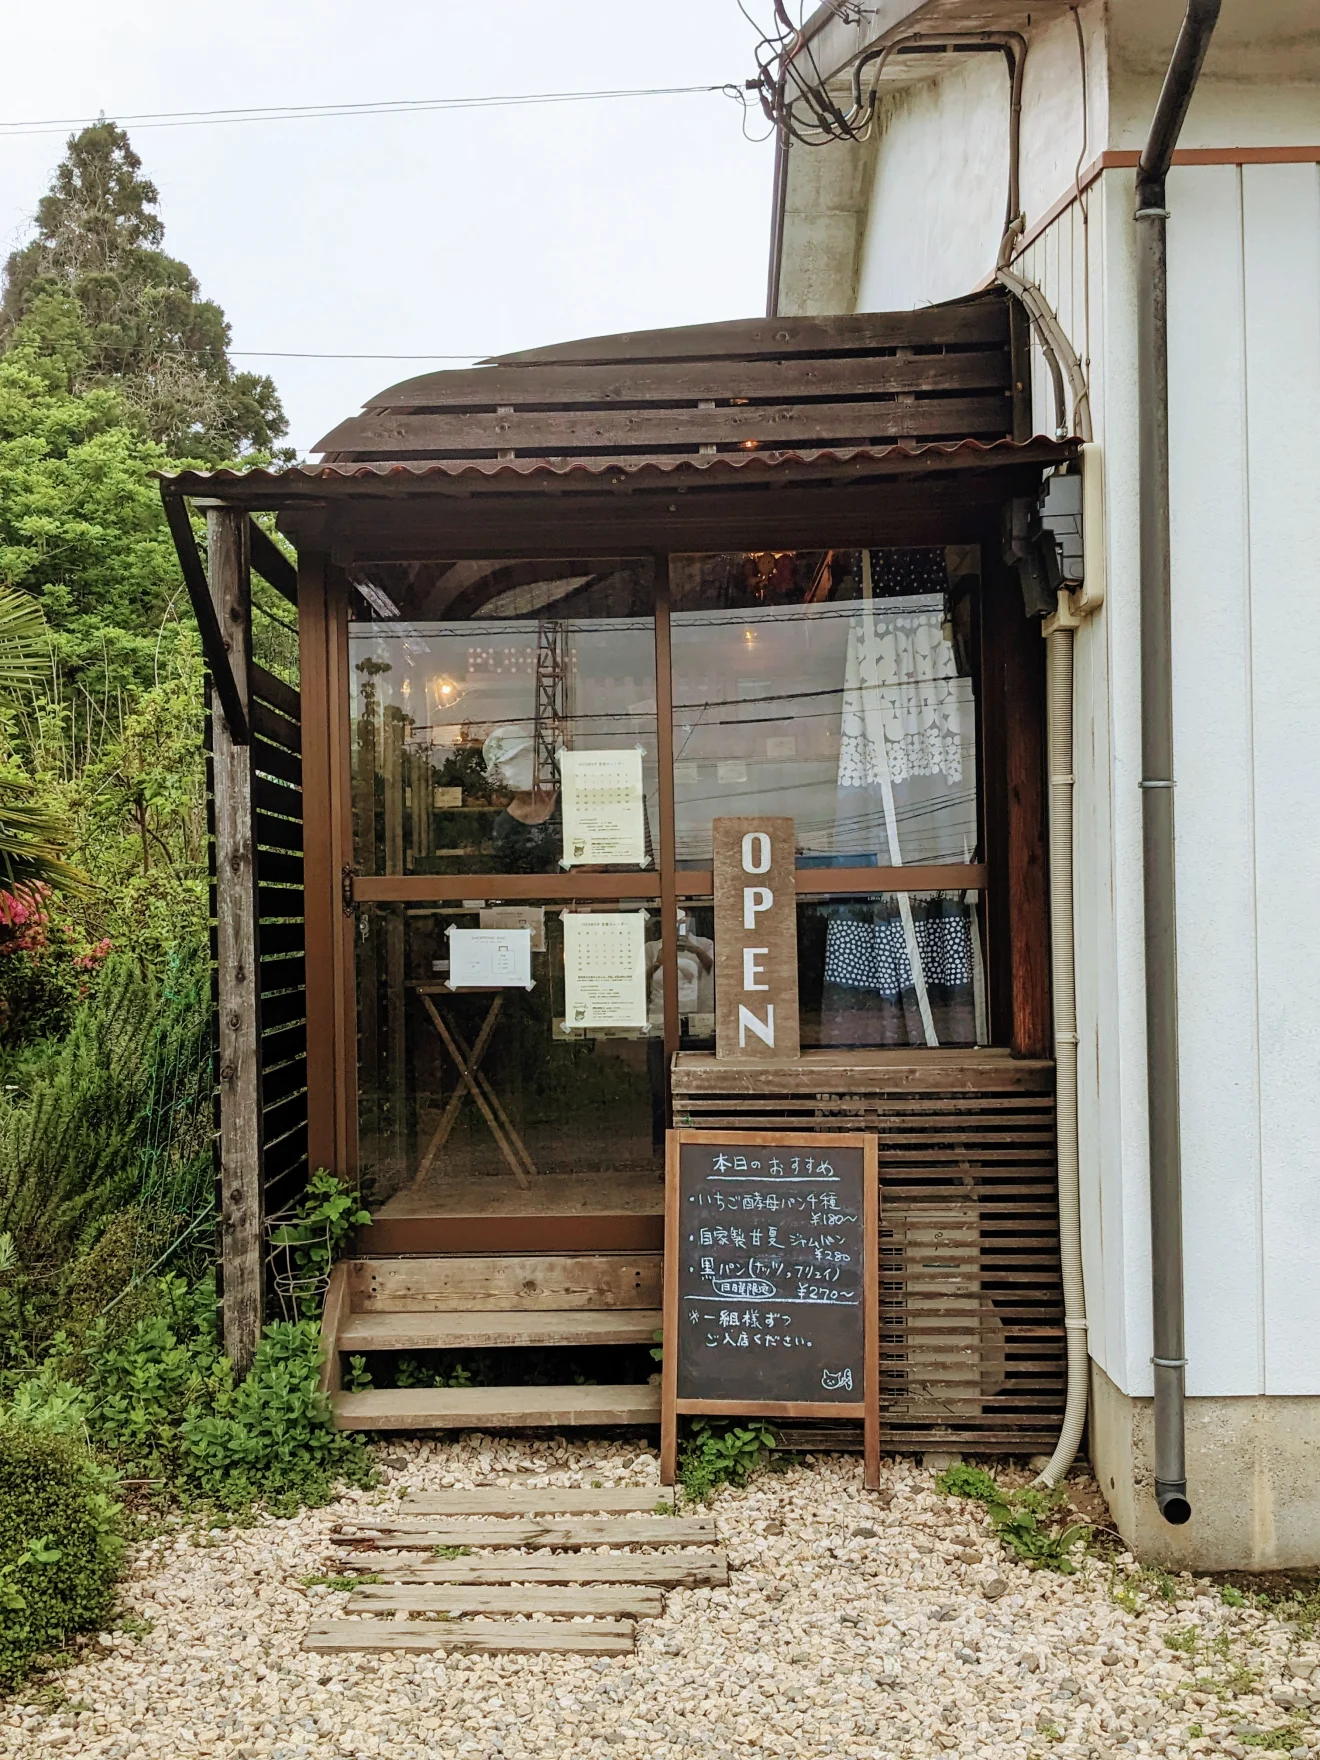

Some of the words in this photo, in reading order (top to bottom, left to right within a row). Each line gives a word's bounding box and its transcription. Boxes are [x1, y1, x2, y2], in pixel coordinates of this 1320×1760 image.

[738, 832, 775, 1048] OPEN
[712, 1152, 834, 1176] 本日のおすすめ
